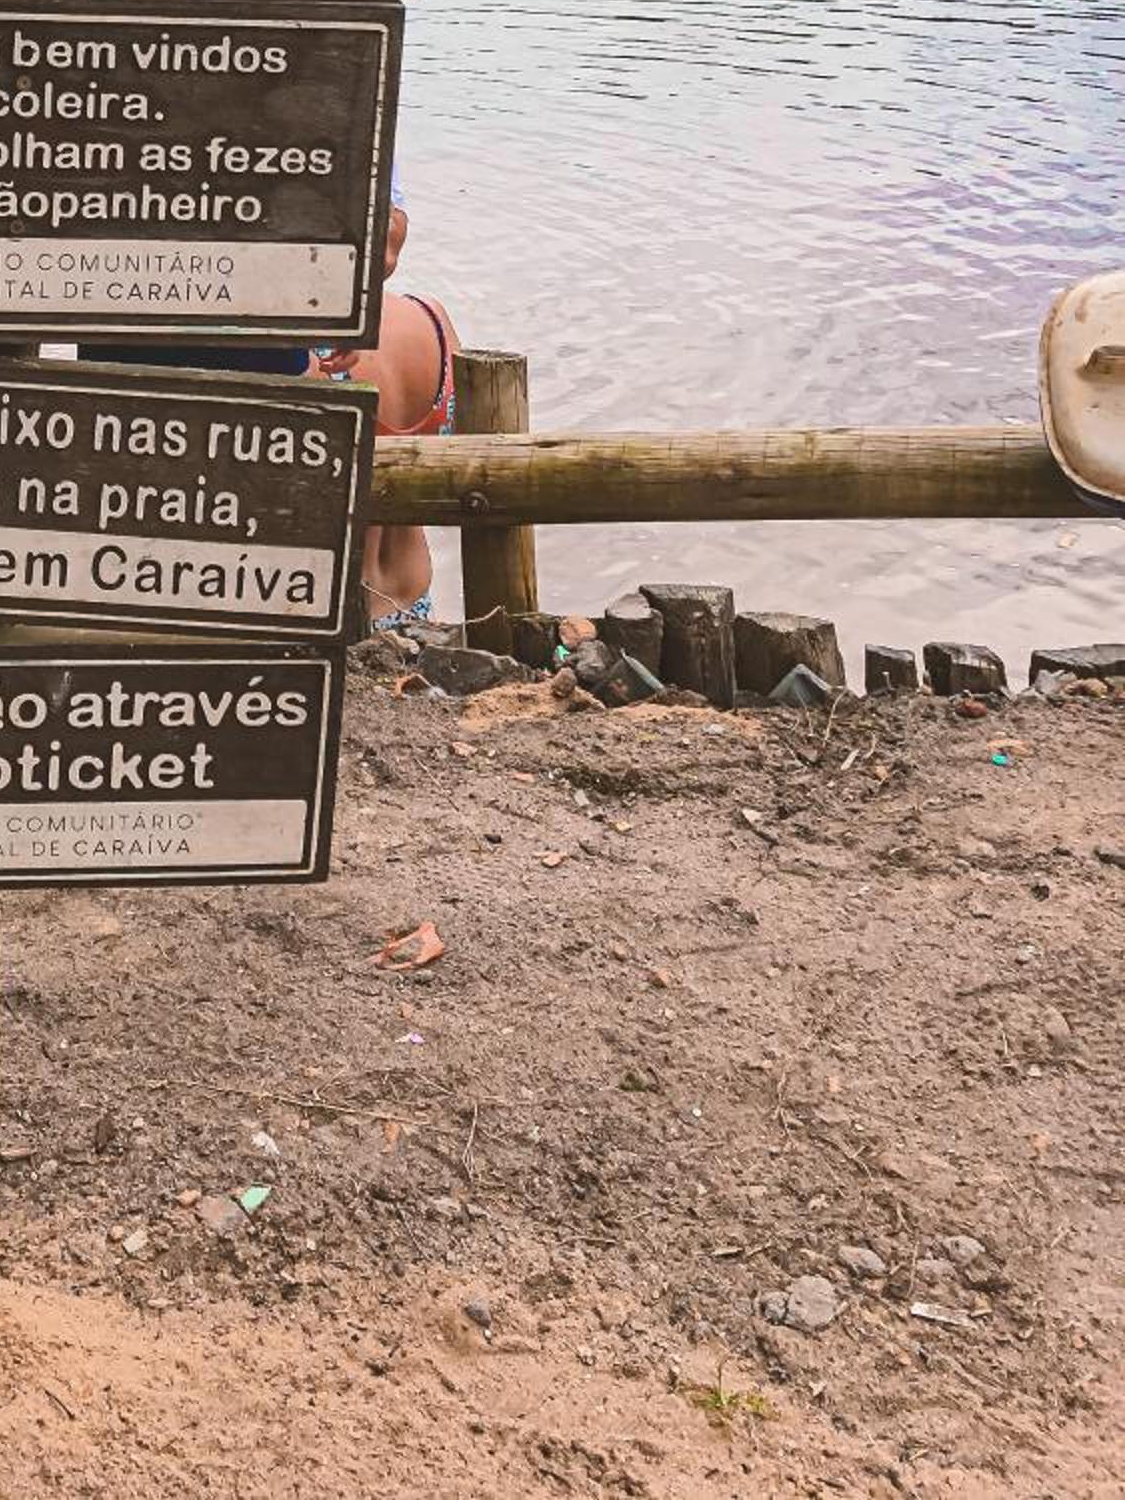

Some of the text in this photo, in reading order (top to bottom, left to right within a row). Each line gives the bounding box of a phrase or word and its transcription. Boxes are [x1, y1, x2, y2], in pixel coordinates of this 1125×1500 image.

[13, 31, 115, 68] bem
[133, 34, 287, 72] vindos
[140, 144, 191, 170] as
[206, 138, 332, 174] fezes
[38, 252, 234, 275] COMUNITÁRIO
[64, 282, 93, 299] DE
[107, 282, 231, 302] CARAÍVA
[95, 414, 186, 456] nas
[209, 423, 342, 476] ruas,
[19, 478, 78, 515] na
[99, 476, 257, 536] praia,
[91, 545, 314, 604] Caraíva
[68, 676, 307, 728] através
[7, 811, 194, 834] COMUNITÁRIO
[33, 841, 59, 856] DE
[73, 839, 189, 856] CARAÍVA
